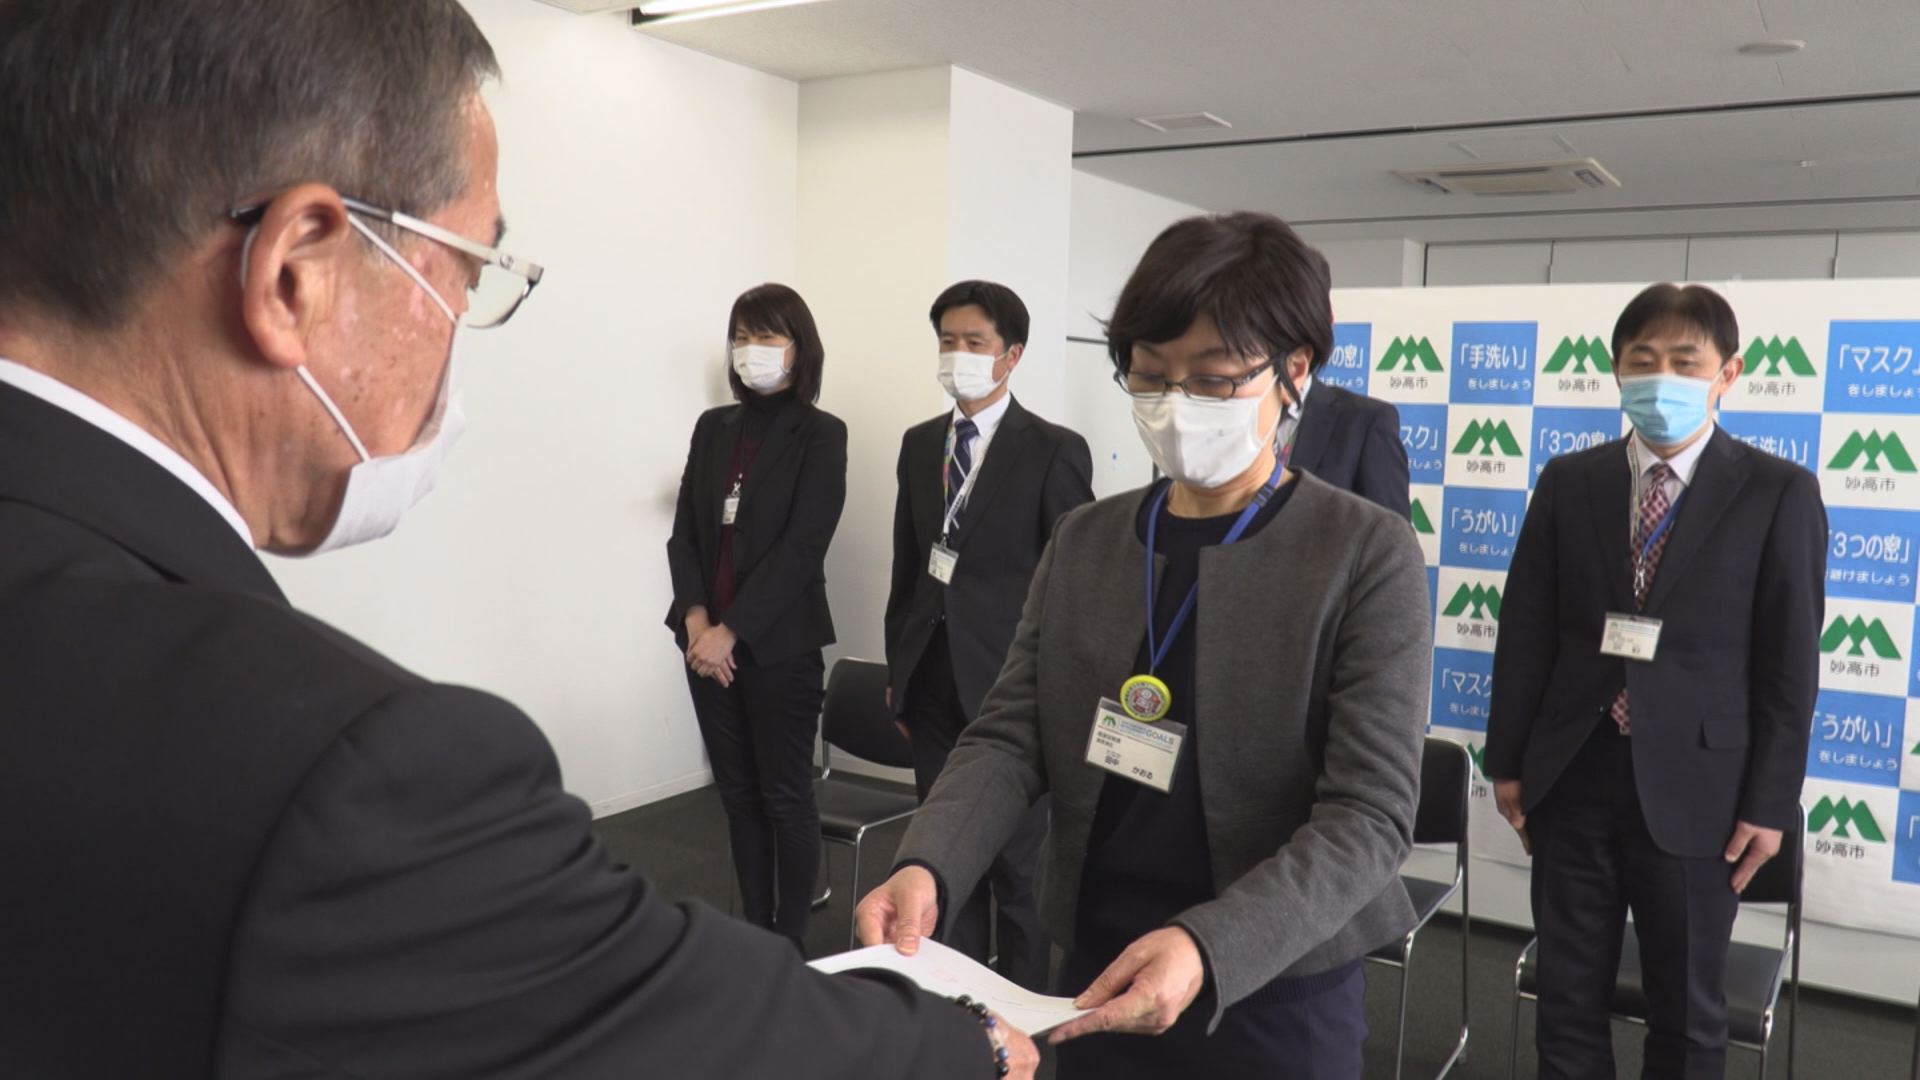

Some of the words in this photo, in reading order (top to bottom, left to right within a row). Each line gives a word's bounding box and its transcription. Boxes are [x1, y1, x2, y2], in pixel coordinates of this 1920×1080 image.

[1328, 343, 1364, 369] の密」
[1460, 344, 1527, 369] 「手洗い」
[1390, 376, 1429, 390] 妙高市
[1558, 379, 1601, 393] 妙高市
[1748, 381, 1796, 396] 妙高市
[1466, 460, 1506, 474] 妙高市
[1845, 476, 1896, 492] 妙高市
[1451, 507, 1516, 537] 「うがい」
[1459, 542, 1513, 557] をしましょ
[1828, 528, 1910, 564] 3つの密」
[1457, 622, 1495, 637] 妙高市
[1830, 659, 1880, 677] 妙高市
[1811, 711, 1892, 748] 「うがい」
[1815, 839, 1865, 859] 妙高市
